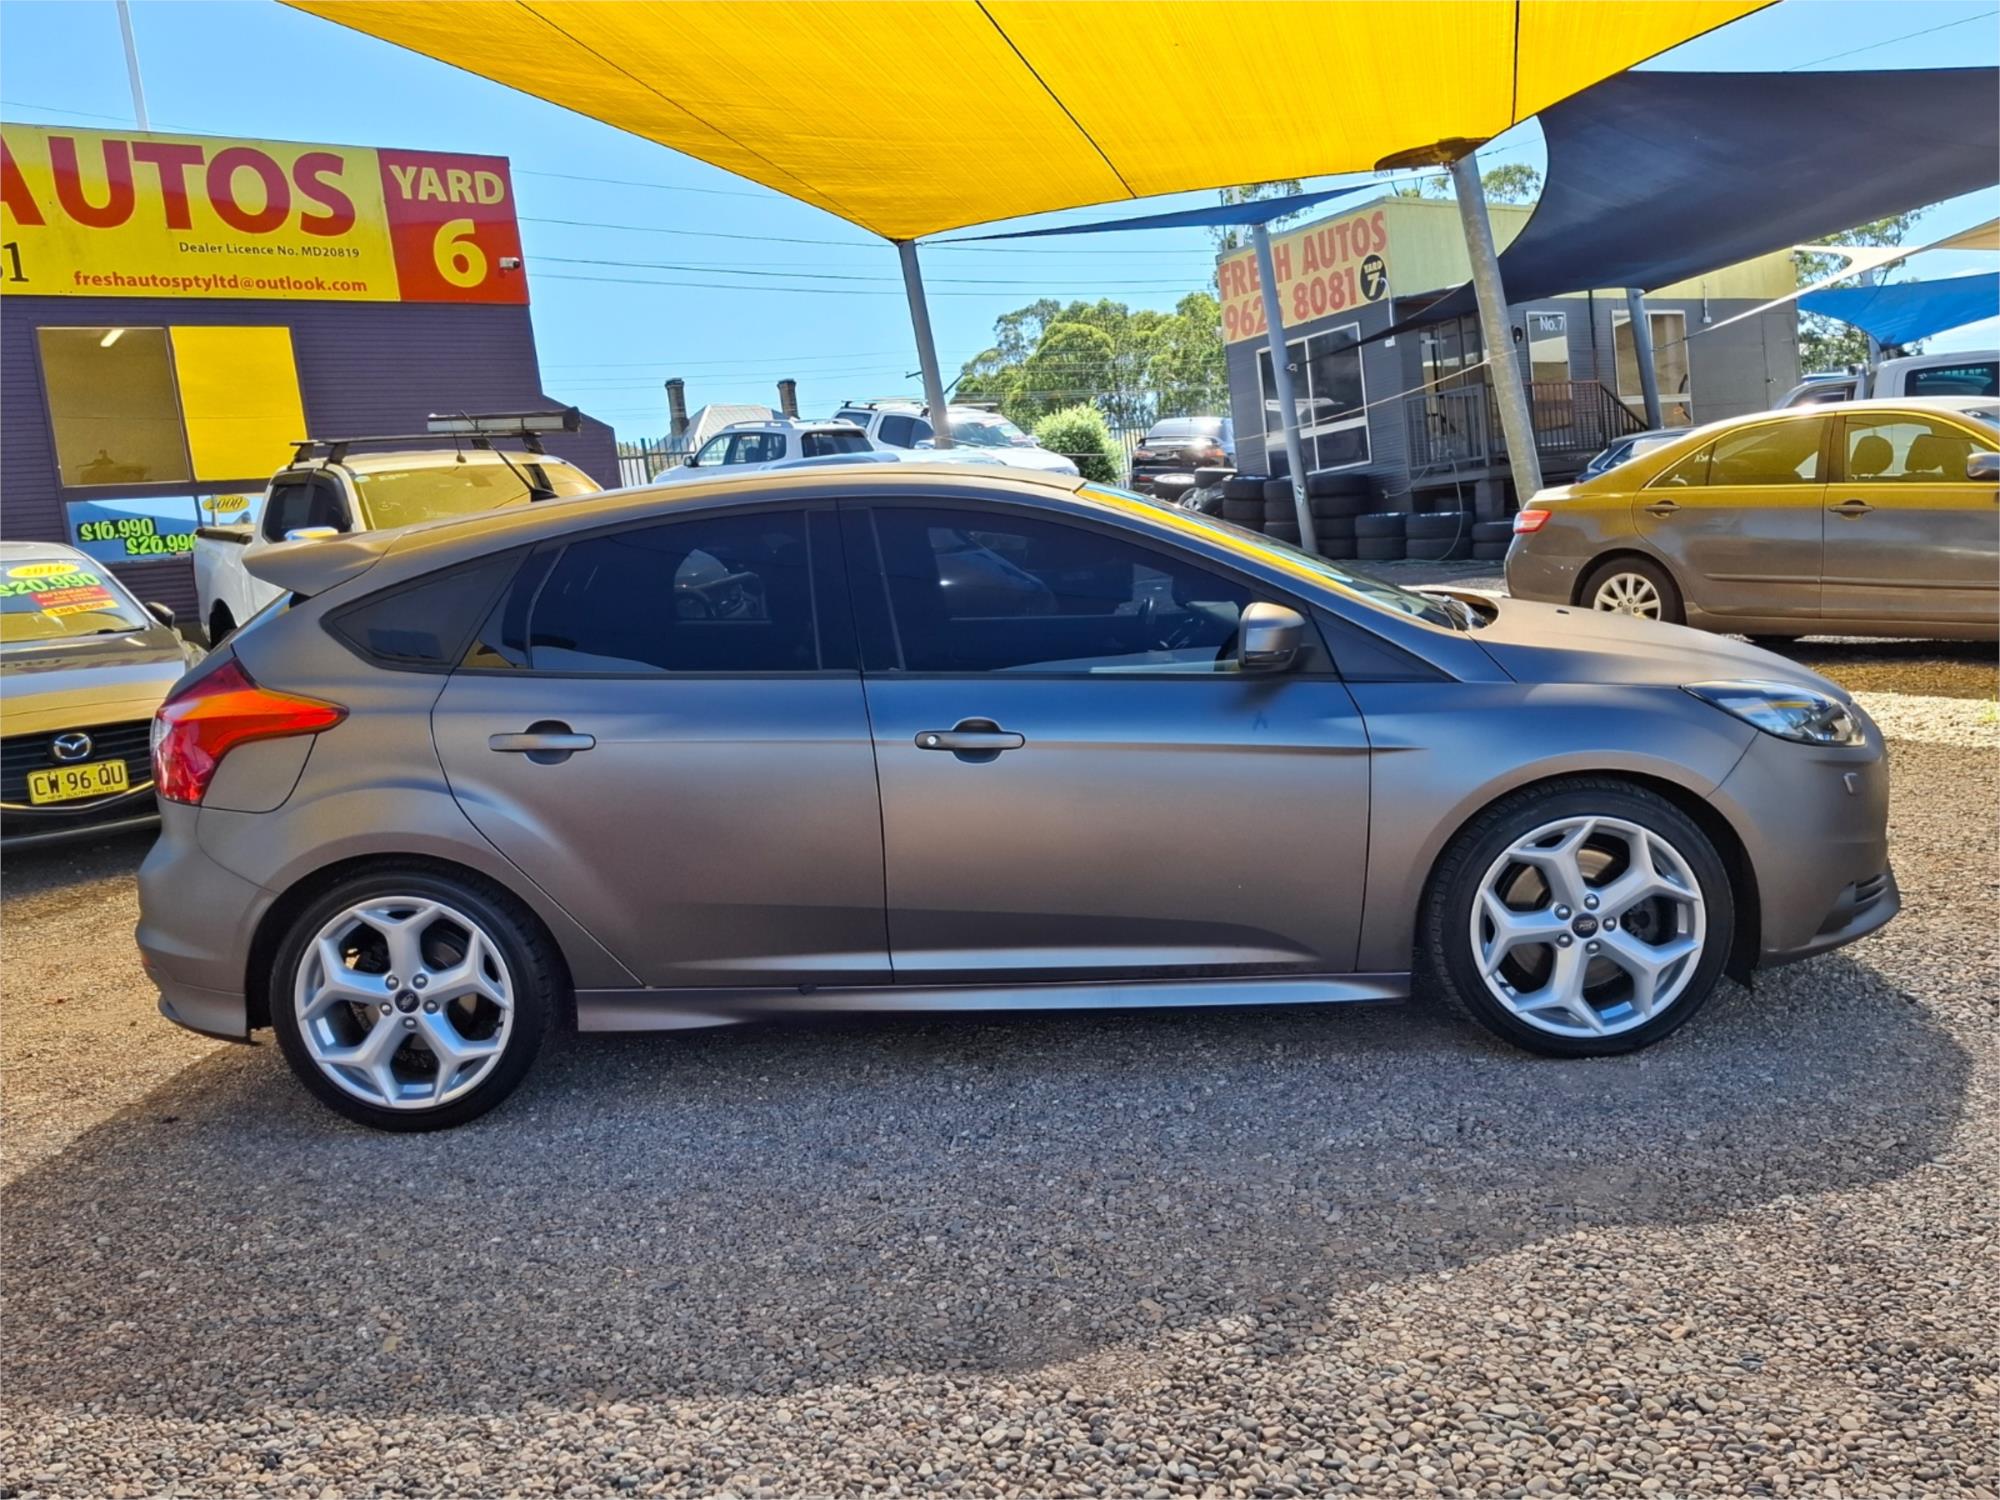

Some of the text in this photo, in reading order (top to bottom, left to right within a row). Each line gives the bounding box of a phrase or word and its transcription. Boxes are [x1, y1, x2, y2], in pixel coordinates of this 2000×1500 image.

[388, 164, 505, 205] YARD
[0, 241, 30, 283] 1
[179, 242, 360, 259] Dealer Licence No. MD20819
[432, 218, 488, 288] 6
[1219, 210, 1387, 301] FREH AUTOS
[73, 270, 368, 293] freshautosptyltd@outlook.com
[1364, 260, 1383, 275] YARD
[1366, 271, 1380, 297] 7
[1224, 266, 1357, 341] 962 8081
[0, 571, 101, 597] $20.990
[33, 764, 123, 796] CW 96 QU
